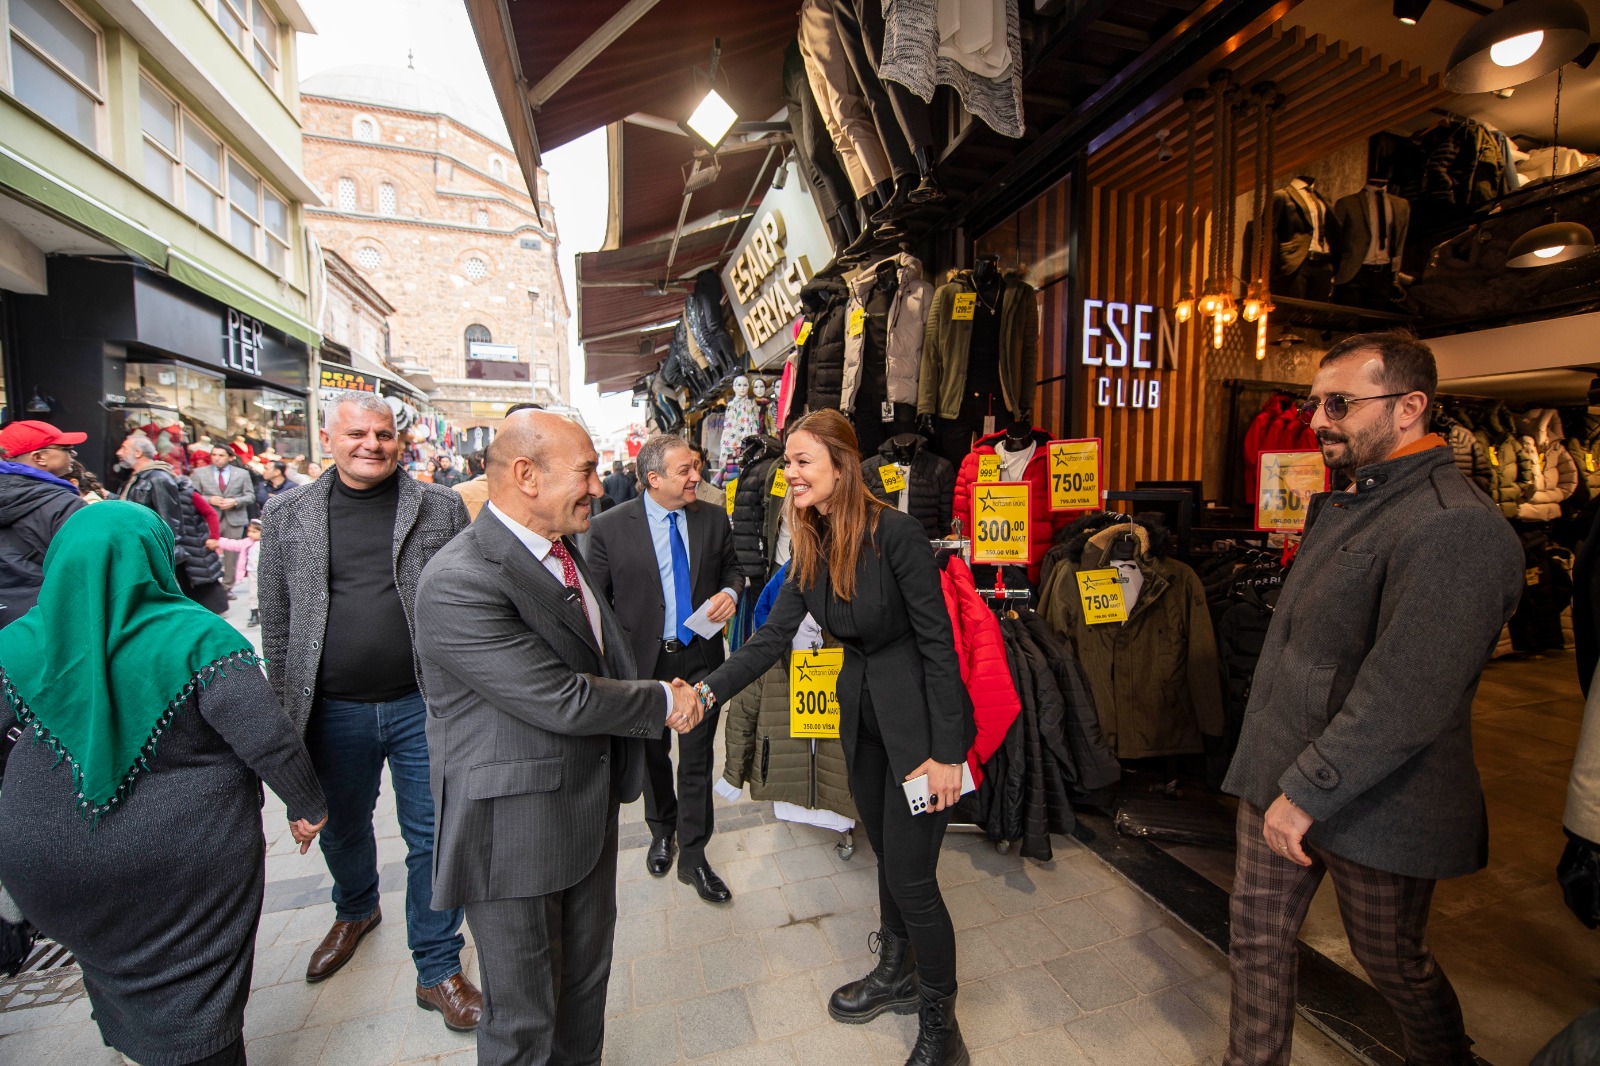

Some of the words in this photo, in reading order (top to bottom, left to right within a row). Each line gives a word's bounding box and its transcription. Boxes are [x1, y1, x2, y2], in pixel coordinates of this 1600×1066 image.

[730, 210, 783, 305] EŞARP
[227, 307, 264, 350] PER
[1082, 299, 1180, 370] ESEN
[1098, 377, 1160, 409] CLUB
